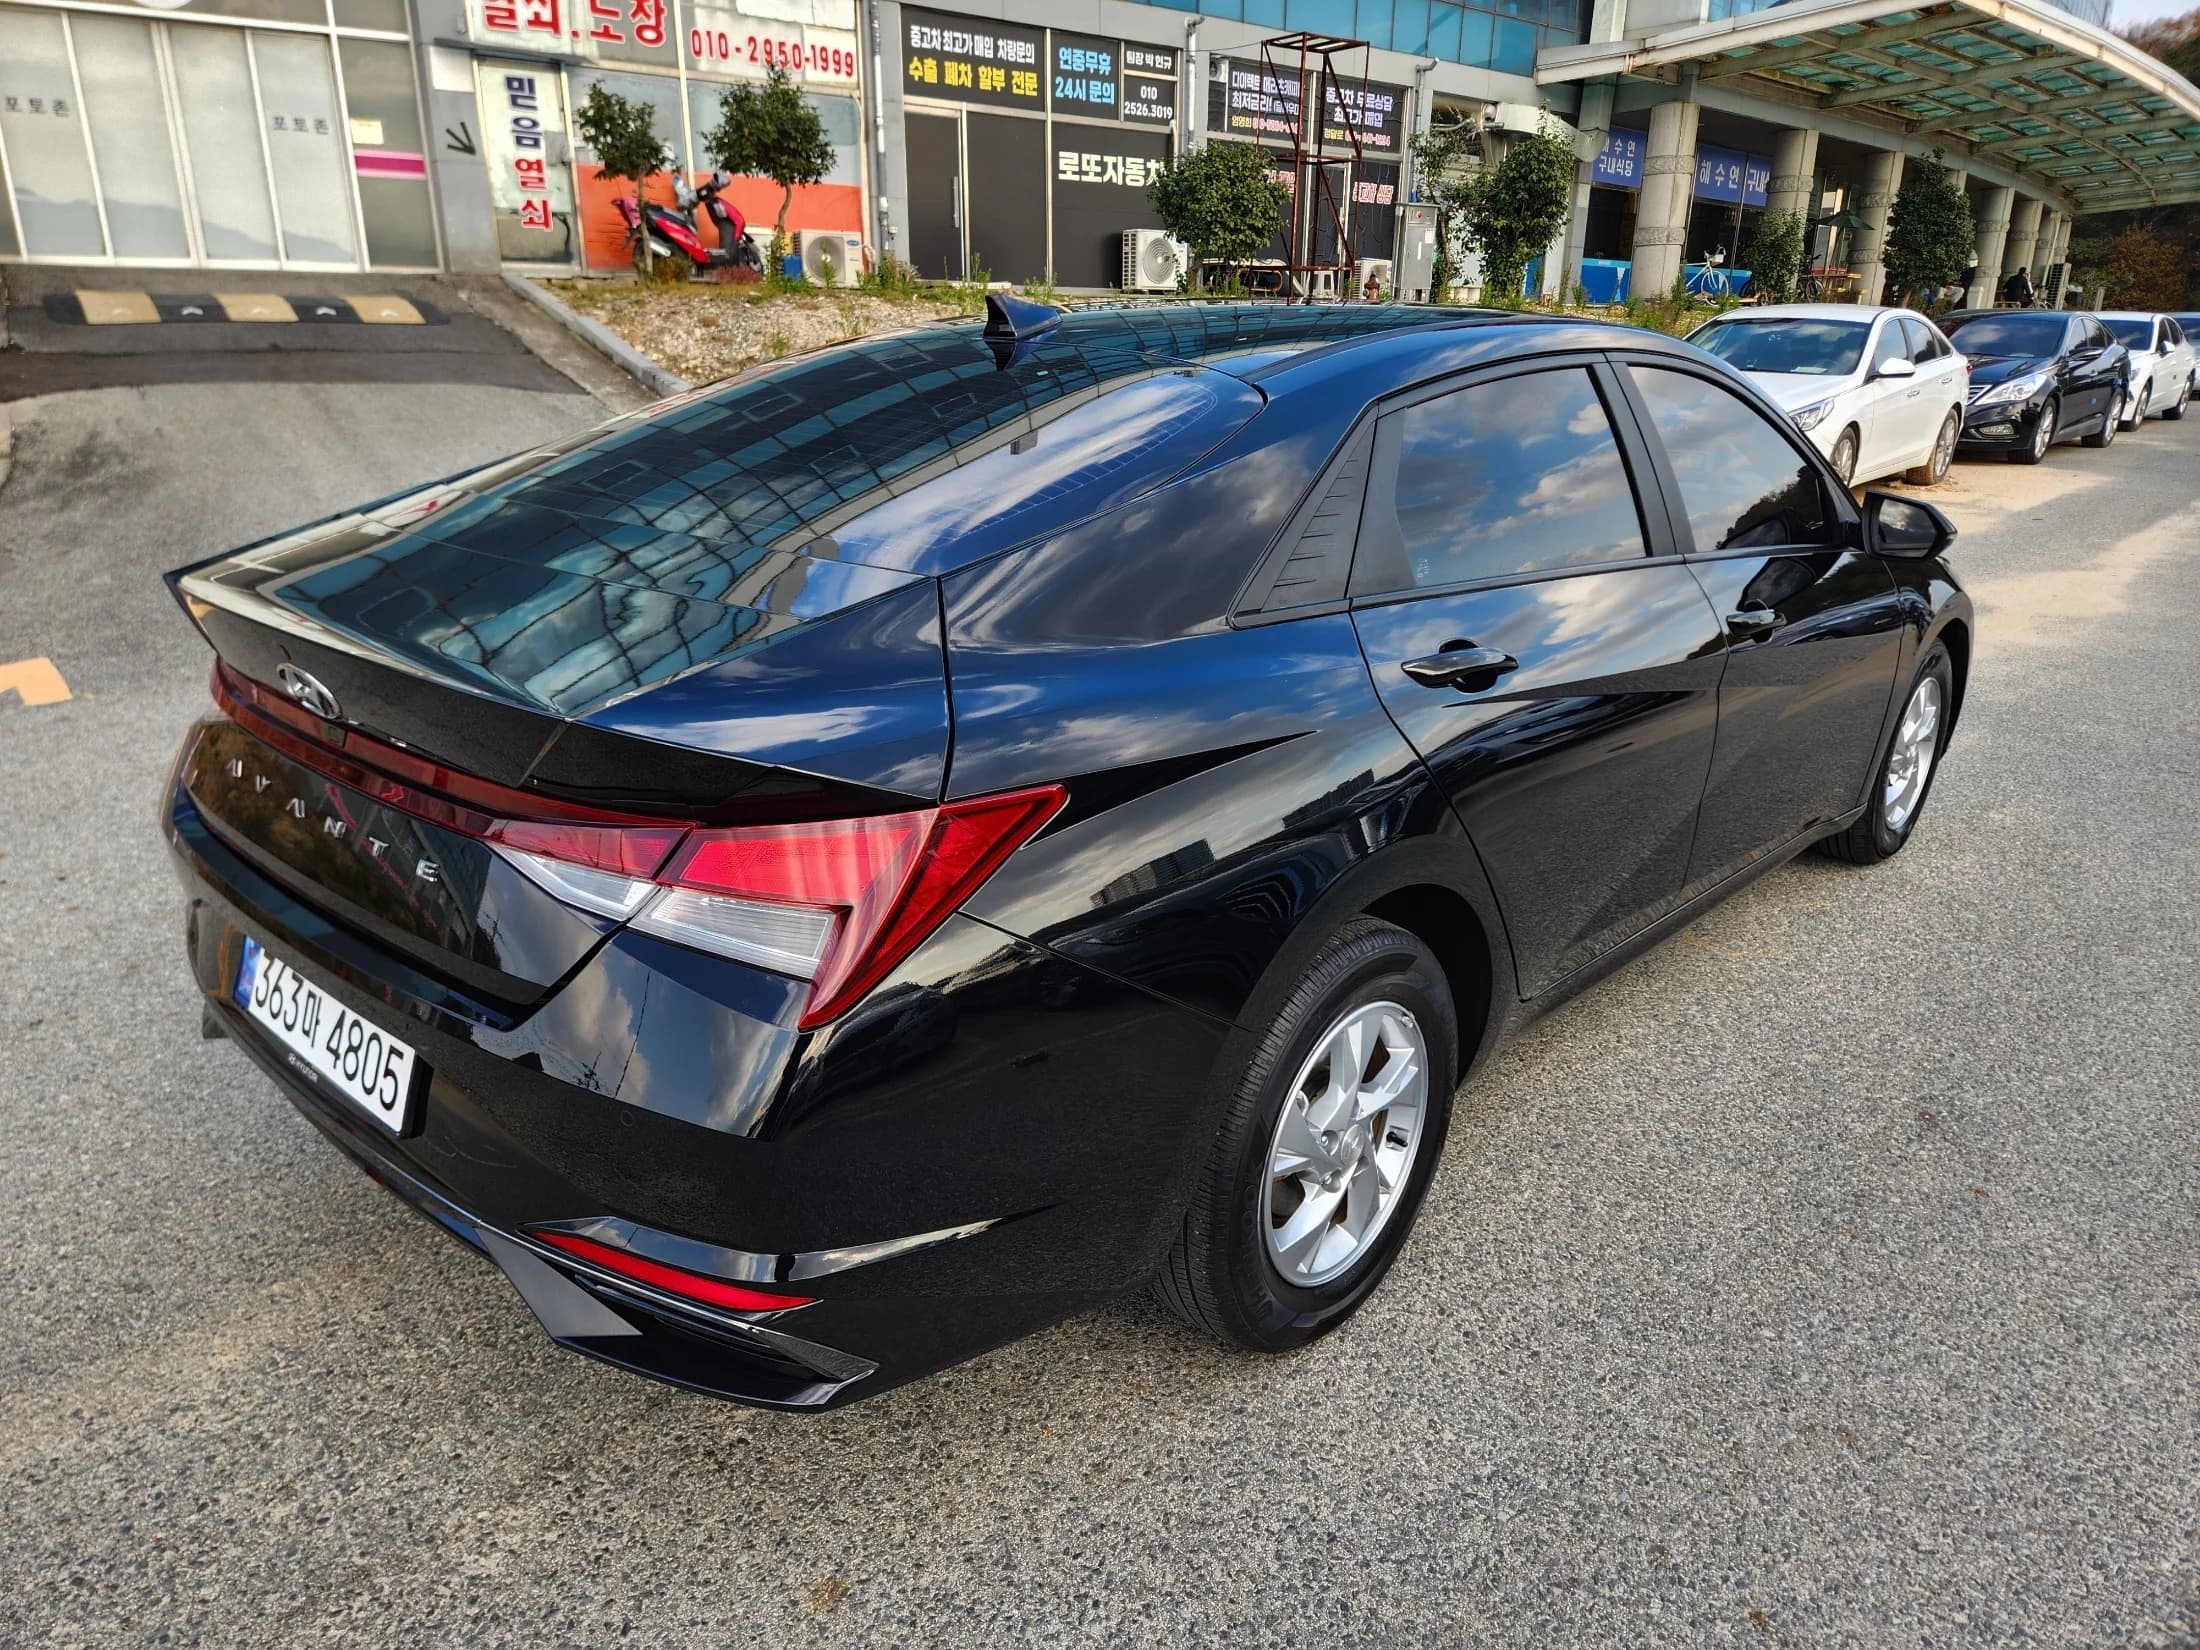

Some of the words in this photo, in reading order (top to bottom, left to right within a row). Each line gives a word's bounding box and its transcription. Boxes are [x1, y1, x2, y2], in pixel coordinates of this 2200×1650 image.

[690, 29, 855, 78] 010-2950-1999
[910, 25, 942, 51] 중고차
[997, 38, 1035, 65] 차량문의
[1059, 47, 1112, 76] 연중무휴
[908, 55, 938, 84] 수출
[978, 65, 1006, 92] 할부
[1011, 70, 1038, 97] 전문
[1055, 76, 1086, 101] 24시
[1089, 80, 1115, 105] 문의
[1140, 85, 1158, 100] 010
[1124, 101, 1173, 119] 2526.3019
[1599, 155, 1634, 177] 구내식당
[226, 758, 440, 883] AVANTE
[255, 951, 322, 1049] 363마
[326, 1009, 404, 1111] 4805
